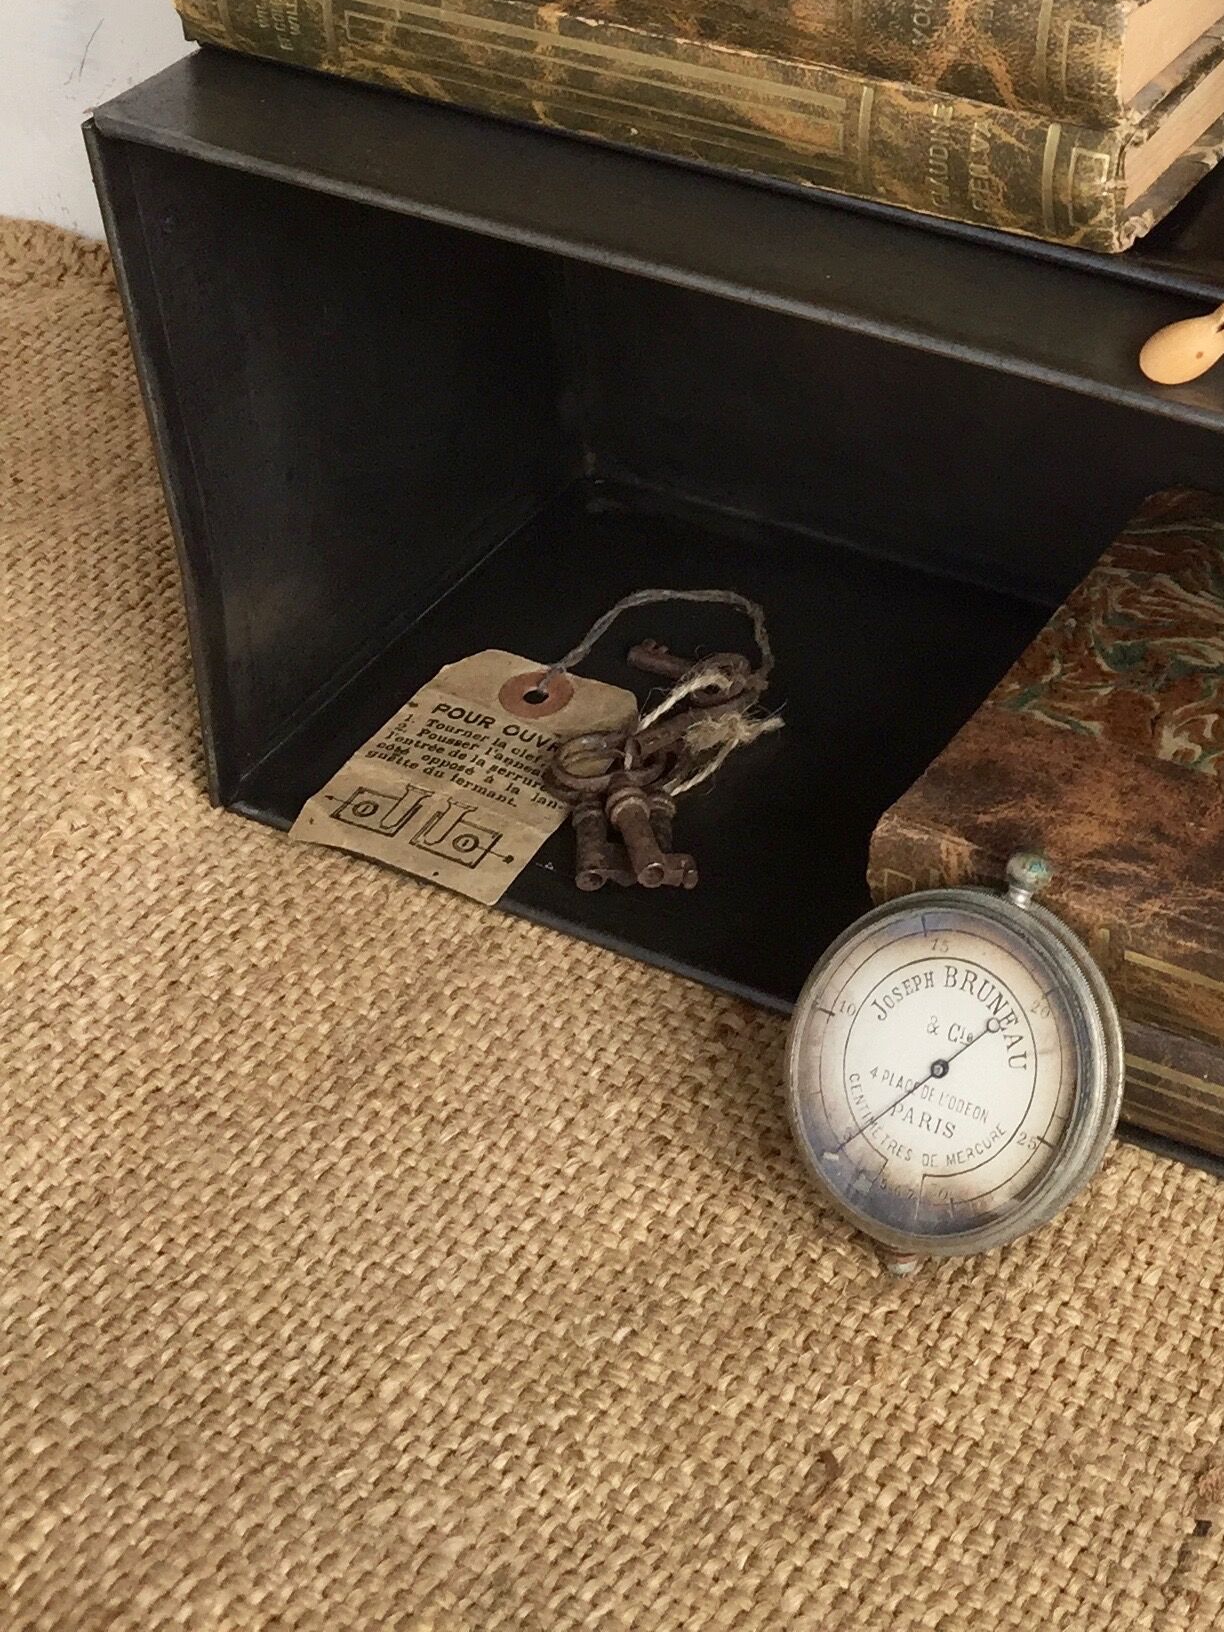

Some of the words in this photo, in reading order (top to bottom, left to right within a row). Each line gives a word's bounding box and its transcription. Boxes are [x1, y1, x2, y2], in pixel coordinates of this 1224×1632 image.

[404, 713, 415, 724] 1.
[427, 718, 490, 743] Tourner
[492, 737, 508, 750] la
[431, 703, 496, 729] POUR
[502, 724, 563, 754] OUVR
[385, 731, 446, 755] l'entrée
[448, 748, 468, 762] de
[470, 755, 486, 768] la
[394, 723, 408, 734] 2.
[416, 727, 480, 752] Pousser
[484, 746, 547, 780] l'annea
[420, 752, 476, 776] opposé
[505, 782, 521, 796] la
[422, 766, 446, 779] du
[838, 998, 858, 1017] 10
[926, 1015, 941, 1037] &
[944, 965, 1029, 1072] BRUNEAU
[869, 1066, 880, 1079] 4
[921, 1084, 935, 1102] DE
[890, 1103, 957, 1140] PARIS
[922, 1153, 938, 1168] DE
[946, 1123, 1008, 1167] MERCURE
[1016, 1130, 1039, 1151] 25
